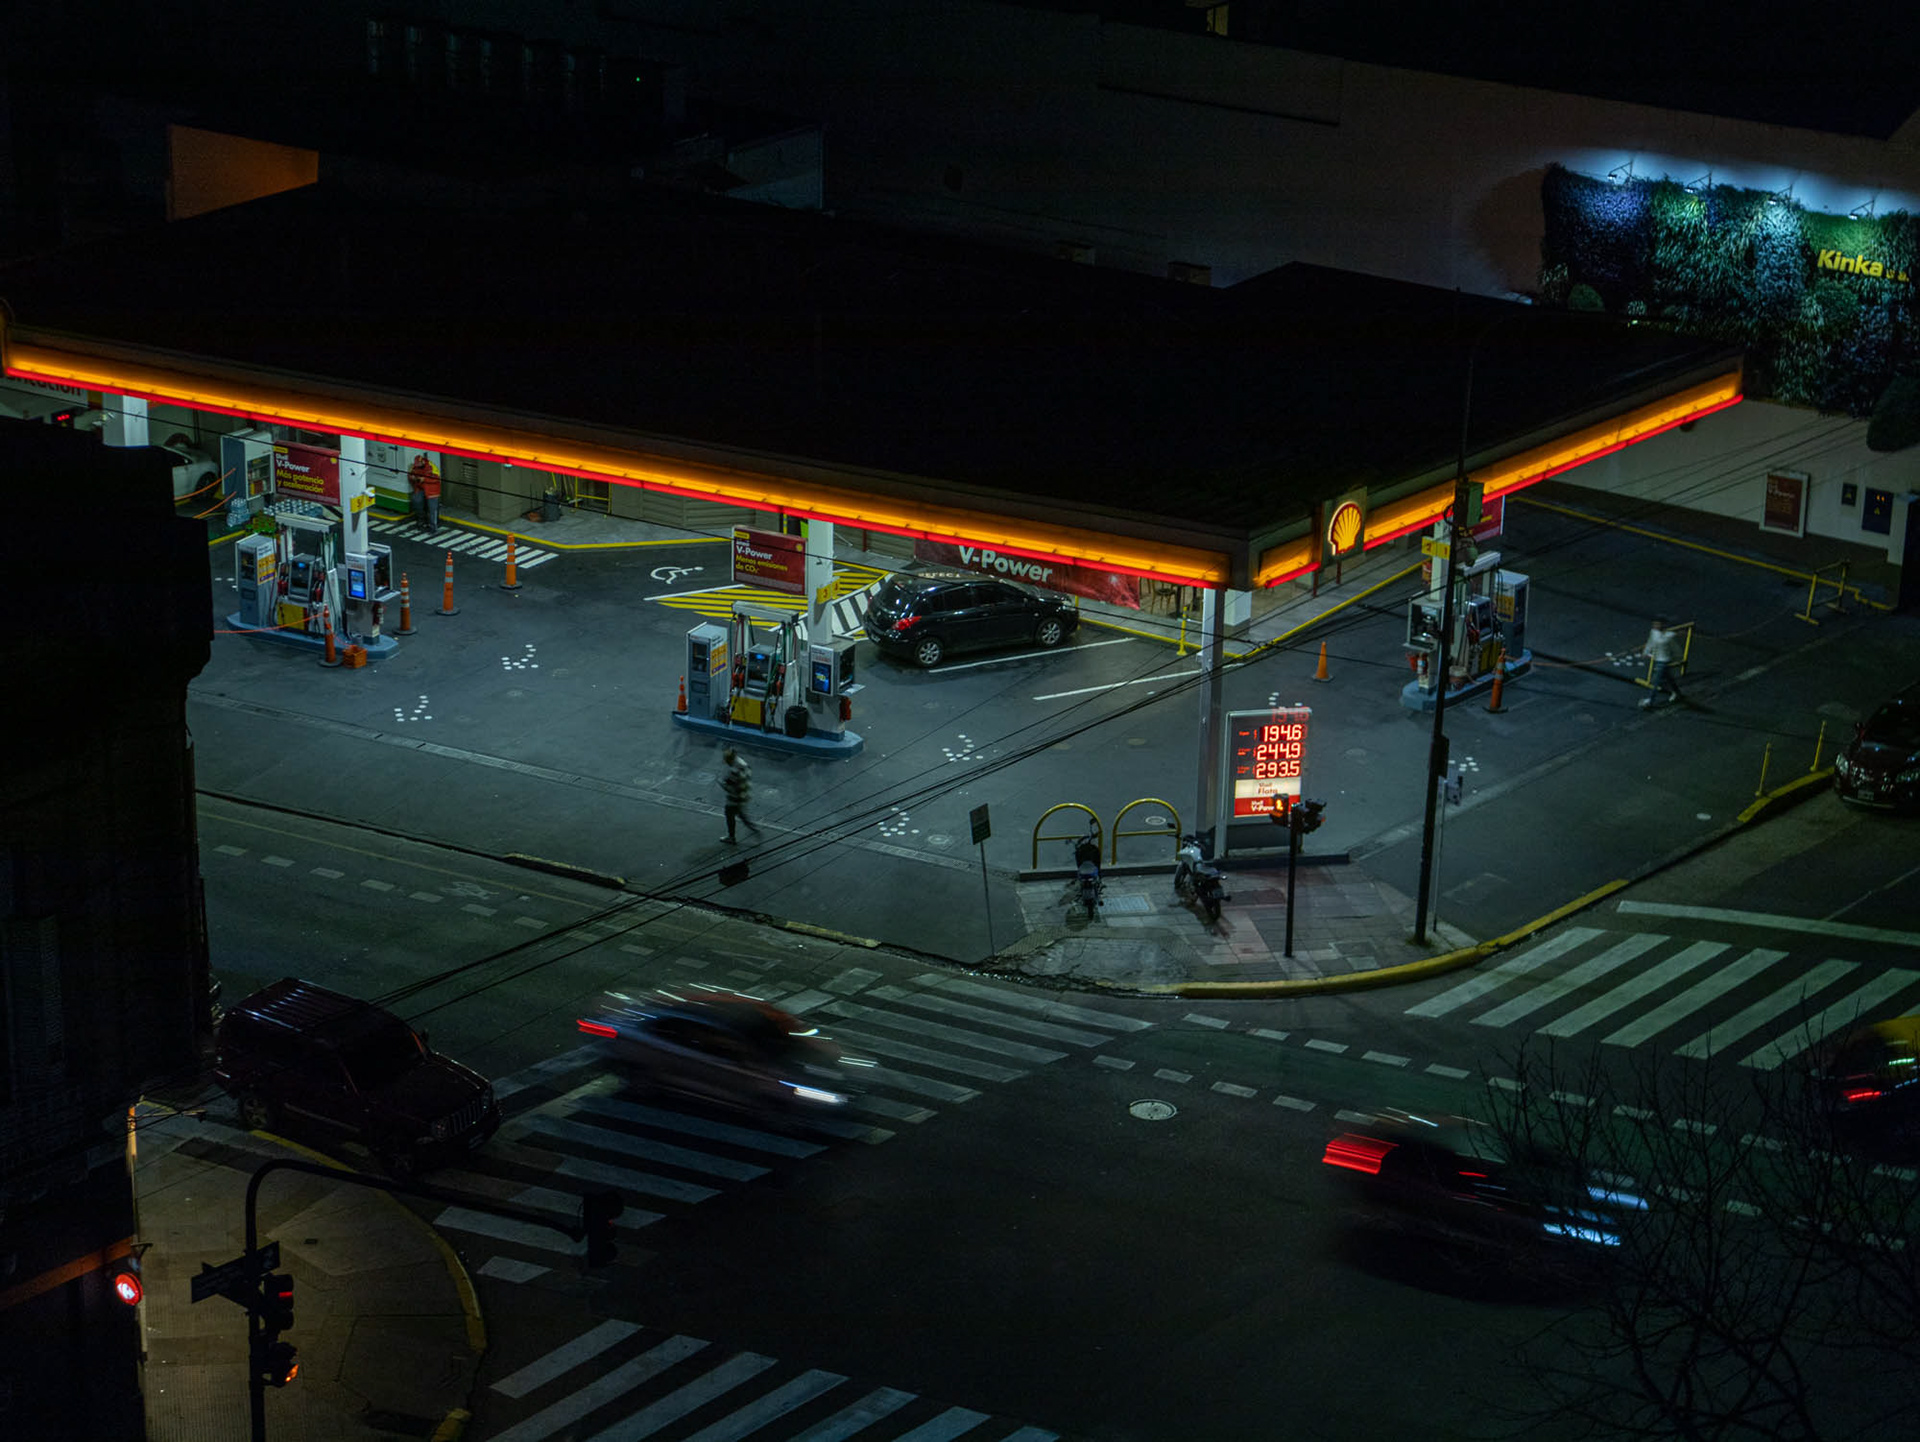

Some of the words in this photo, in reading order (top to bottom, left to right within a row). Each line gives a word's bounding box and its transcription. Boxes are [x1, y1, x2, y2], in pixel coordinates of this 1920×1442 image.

[1817, 249, 1883, 277] Kinka
[276, 460, 310, 473] V-Power
[736, 546, 773, 560] V-Power
[959, 545, 1053, 583] V-Power
[1264, 724, 1302, 742] 194.6
[1257, 742, 1301, 760] 244.9
[1256, 760, 1300, 778] 293.5
